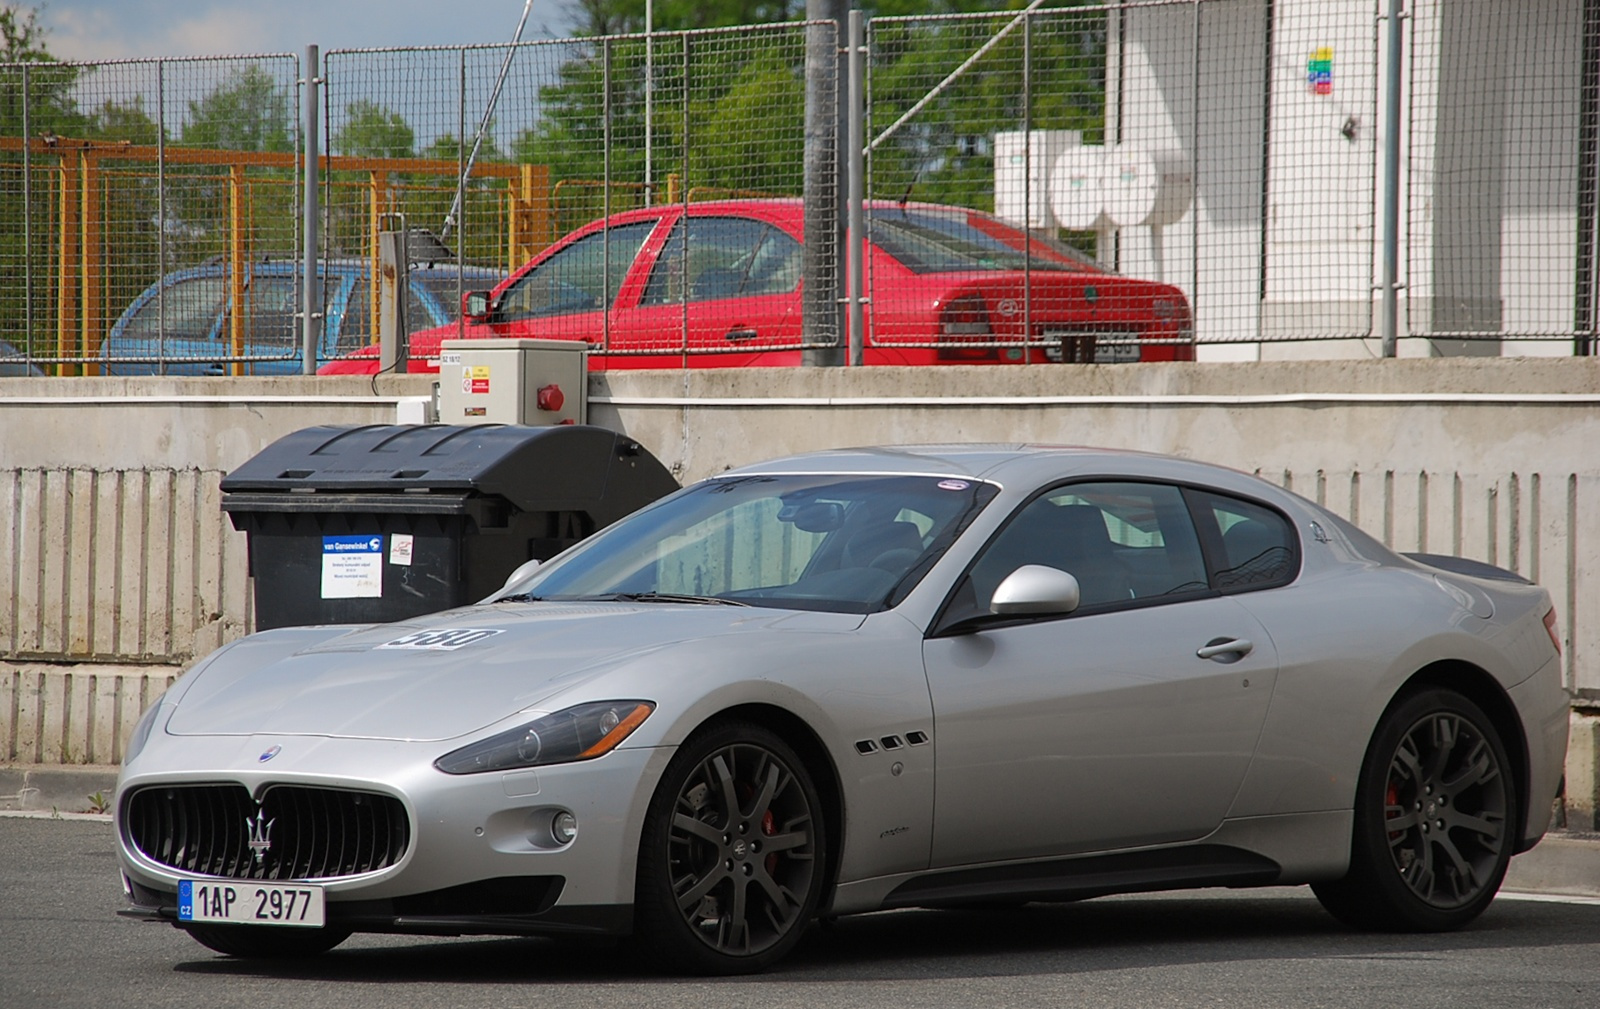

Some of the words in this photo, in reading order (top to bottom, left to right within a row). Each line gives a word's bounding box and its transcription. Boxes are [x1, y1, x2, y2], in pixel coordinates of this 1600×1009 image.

[335, 542, 368, 550] Gansewinkel
[387, 629, 499, 647] 580
[180, 905, 191, 916] CZ
[198, 886, 237, 918] 1AP
[255, 888, 312, 921] 2977
